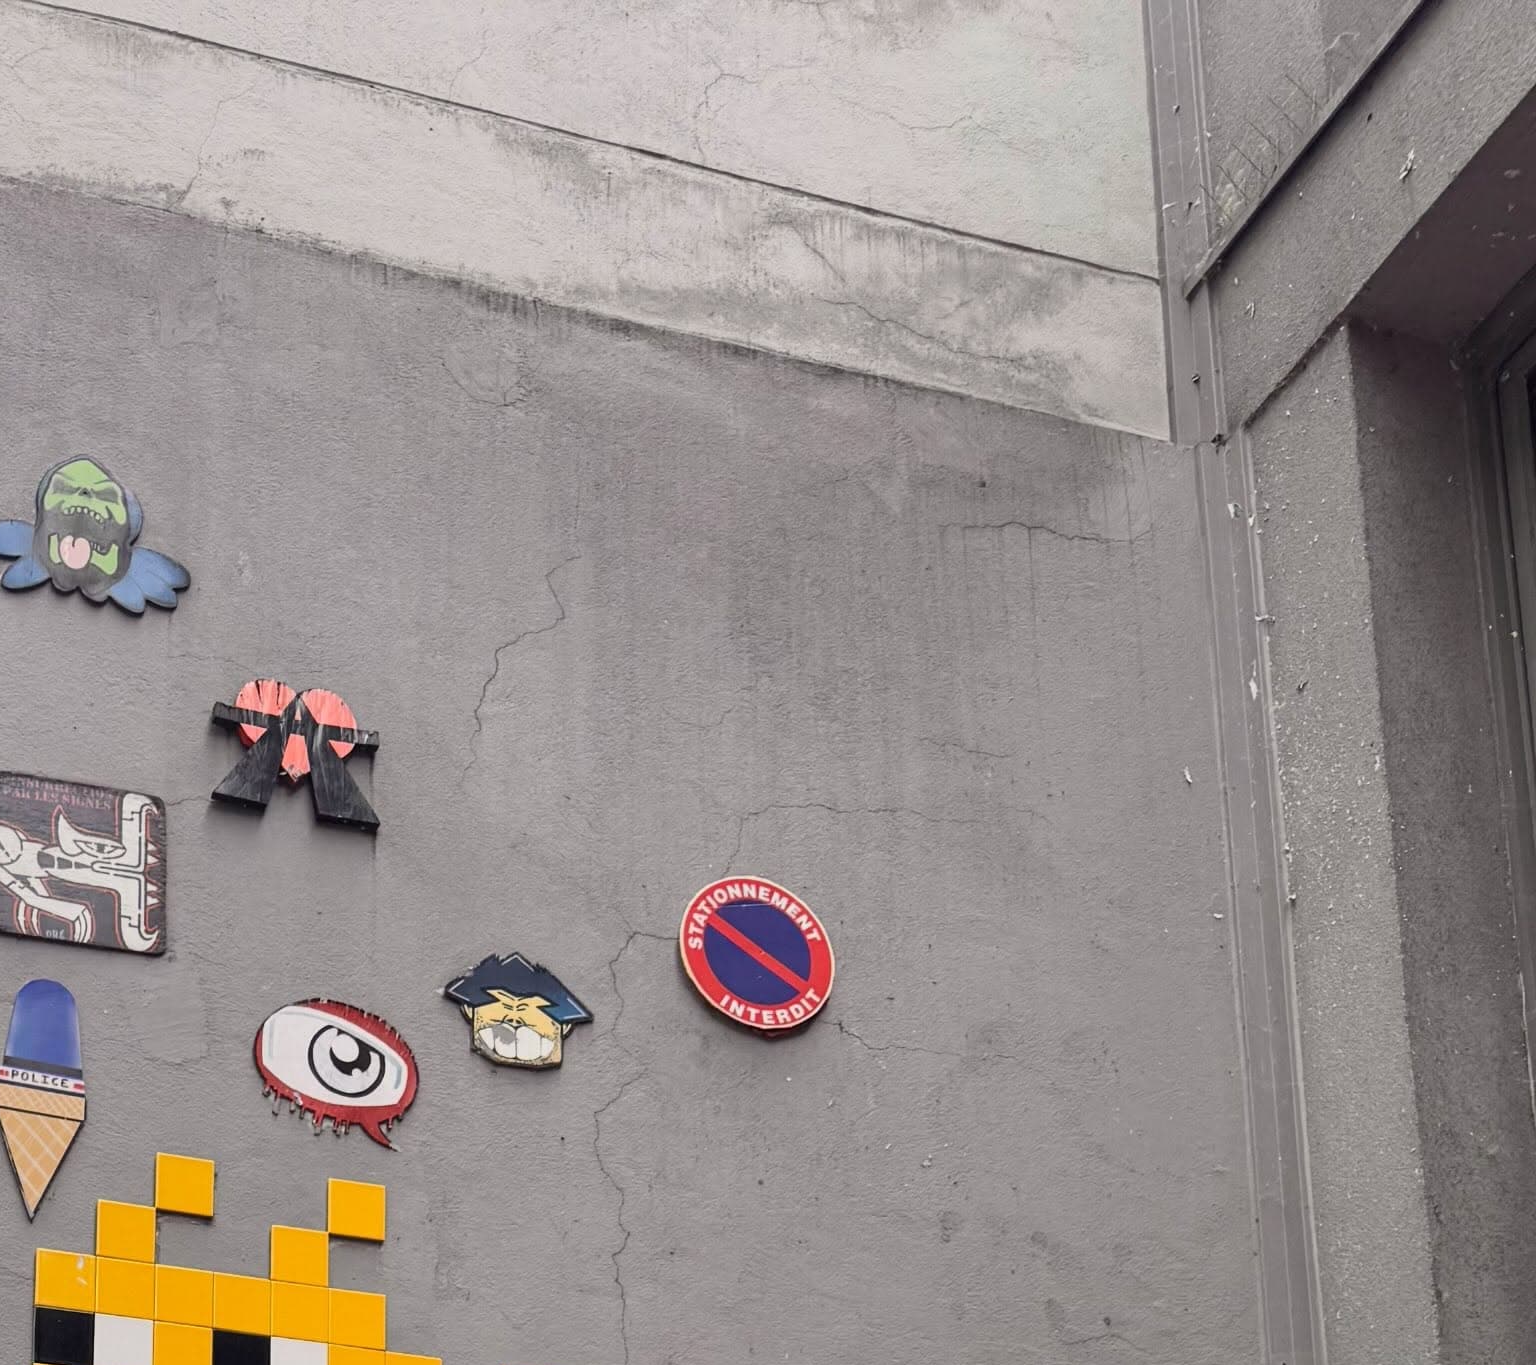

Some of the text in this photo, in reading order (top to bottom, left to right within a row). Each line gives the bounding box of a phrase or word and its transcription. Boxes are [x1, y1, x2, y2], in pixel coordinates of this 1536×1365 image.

[63, 793, 112, 810] SIGNES
[688, 883, 821, 950] STATIONNEMENT
[719, 988, 821, 1025] INTERDIT
[10, 1068, 70, 1088] POLICE
